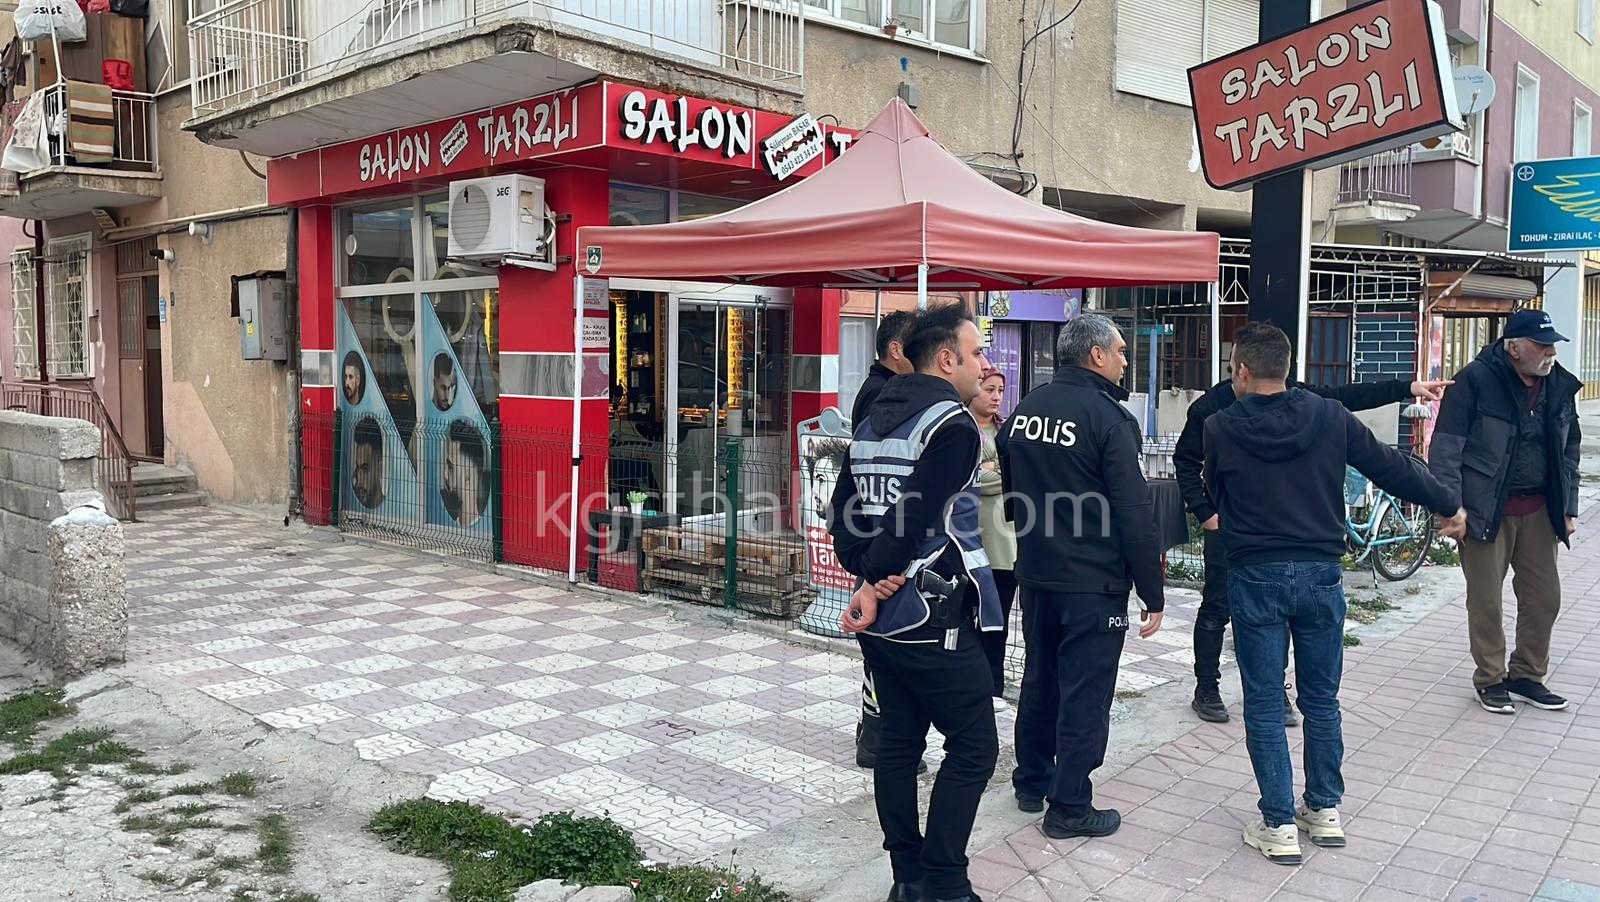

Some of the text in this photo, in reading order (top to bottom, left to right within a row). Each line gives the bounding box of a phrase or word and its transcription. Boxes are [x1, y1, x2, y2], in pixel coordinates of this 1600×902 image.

[1220, 16, 1392, 105] SALON
[620, 90, 752, 159] SALON
[359, 130, 430, 183] SALON
[1519, 233, 1548, 243] TOHUM
[809, 541, 843, 568] Tar
